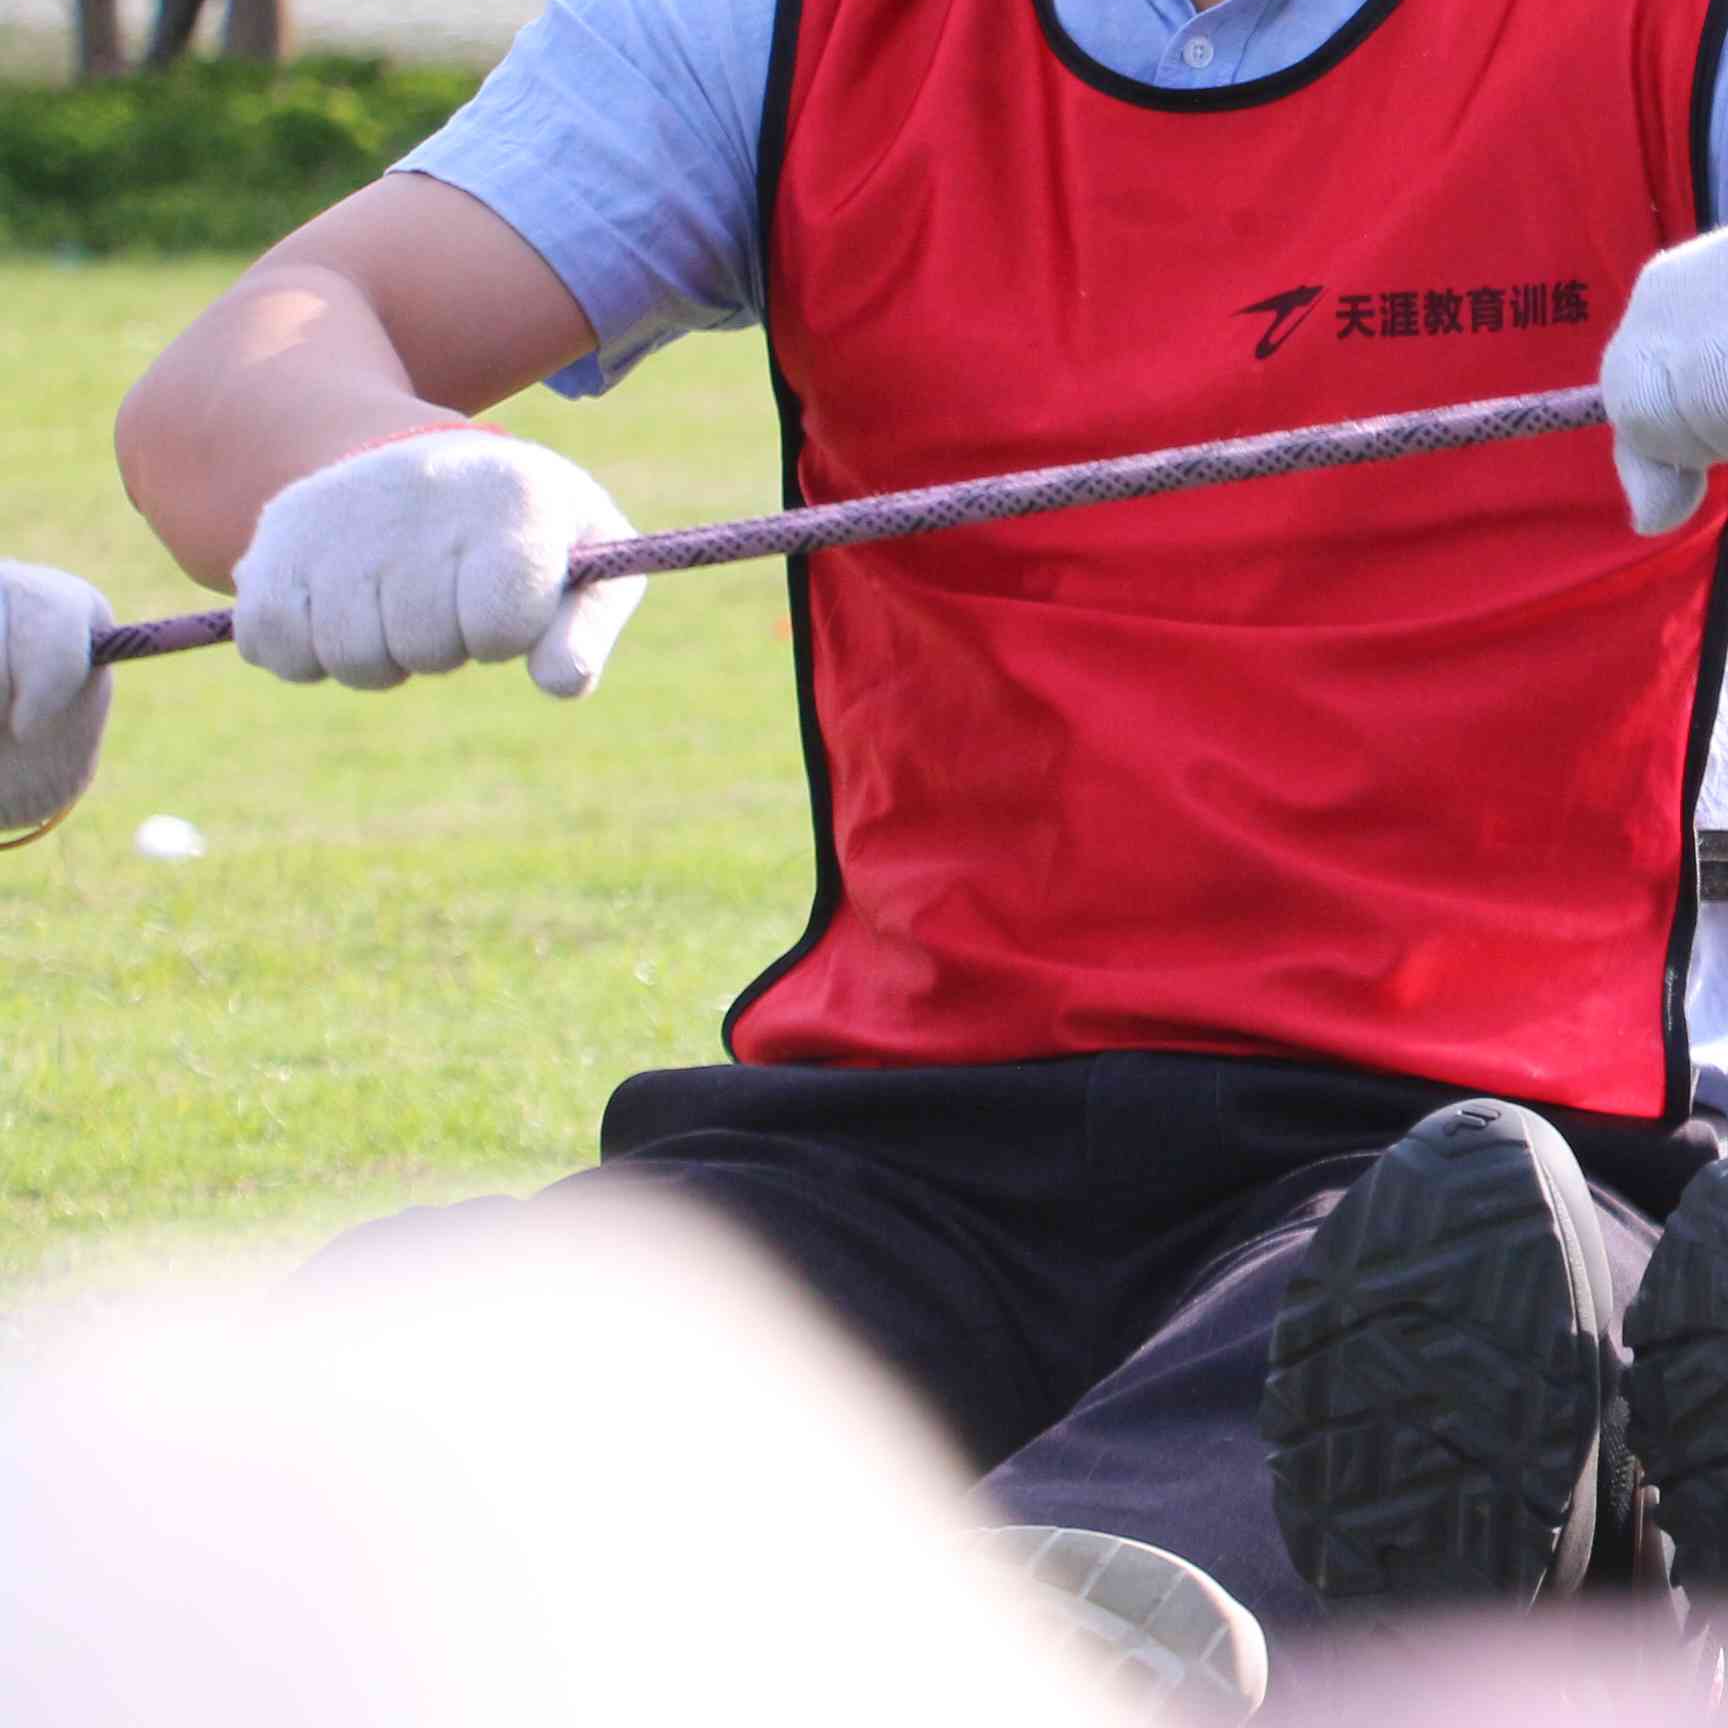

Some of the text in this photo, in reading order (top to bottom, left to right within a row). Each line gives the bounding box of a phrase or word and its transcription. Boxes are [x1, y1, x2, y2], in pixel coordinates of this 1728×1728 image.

[1336, 280, 1590, 339] 天涯教育训练
